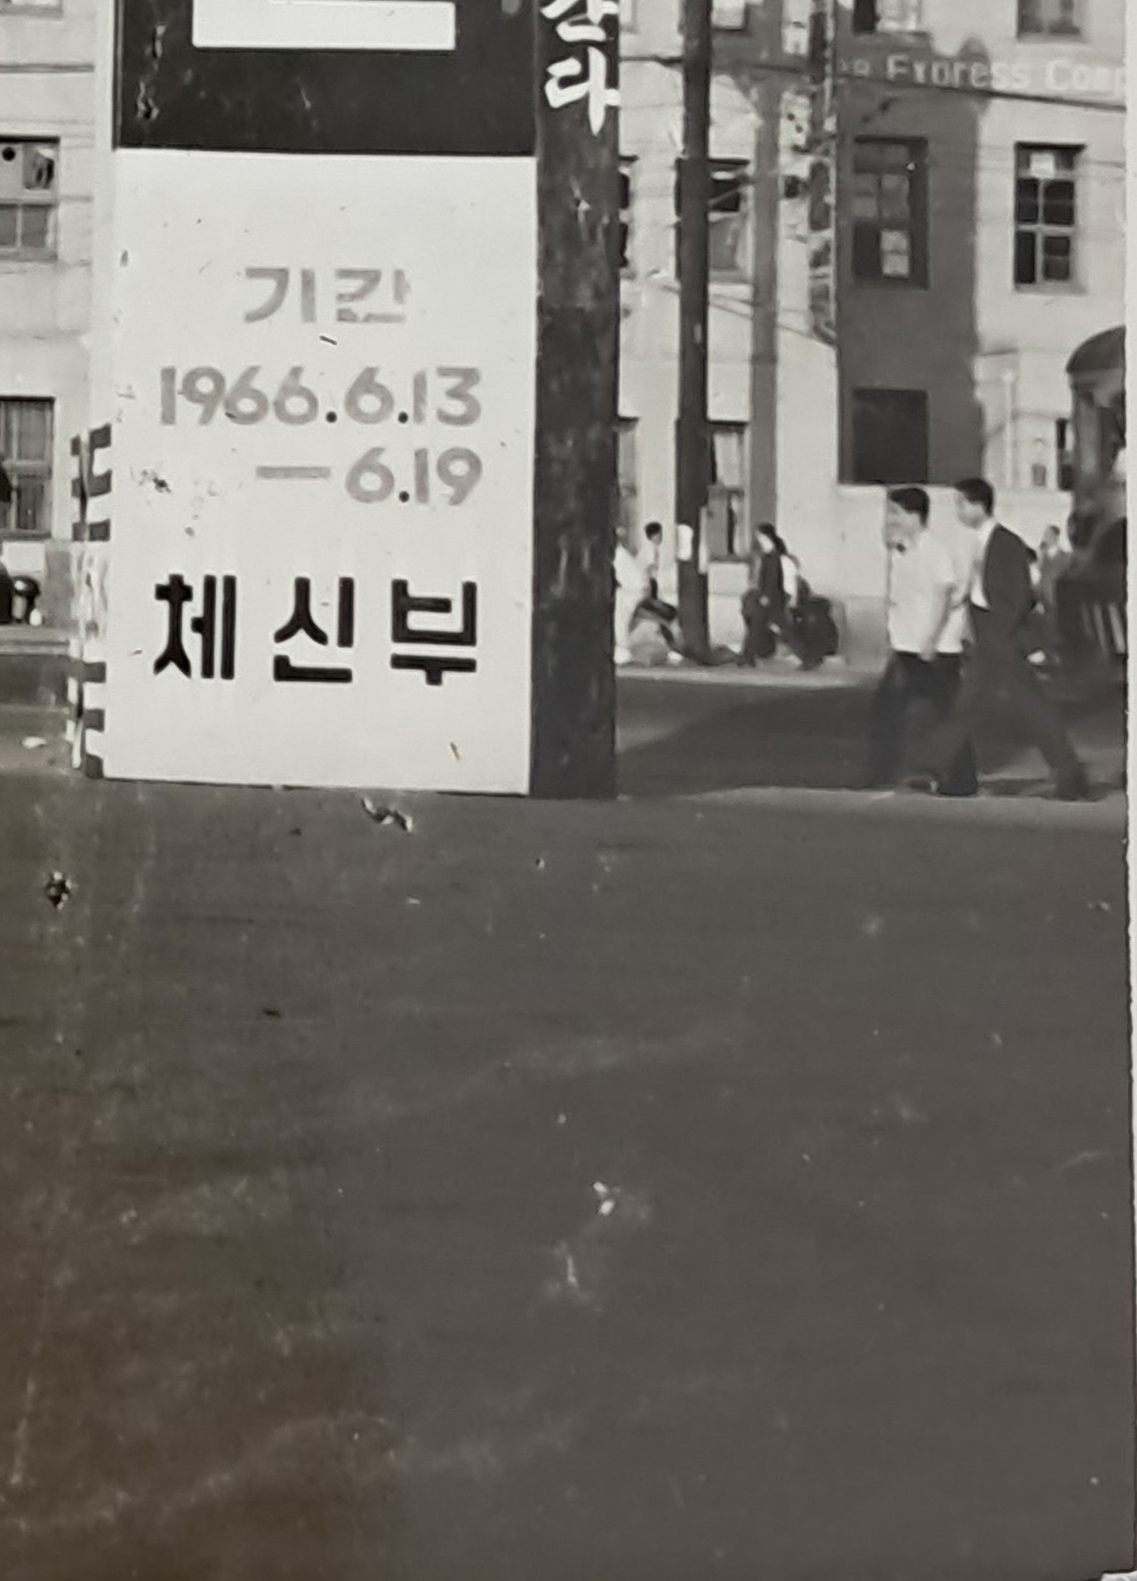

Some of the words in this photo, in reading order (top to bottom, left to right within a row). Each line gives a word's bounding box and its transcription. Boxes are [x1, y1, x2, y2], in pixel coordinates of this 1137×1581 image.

[244, 266, 412, 325] 기간
[160, 365, 482, 427] 1966.6.13
[153, 574, 478, 687] 체신부
